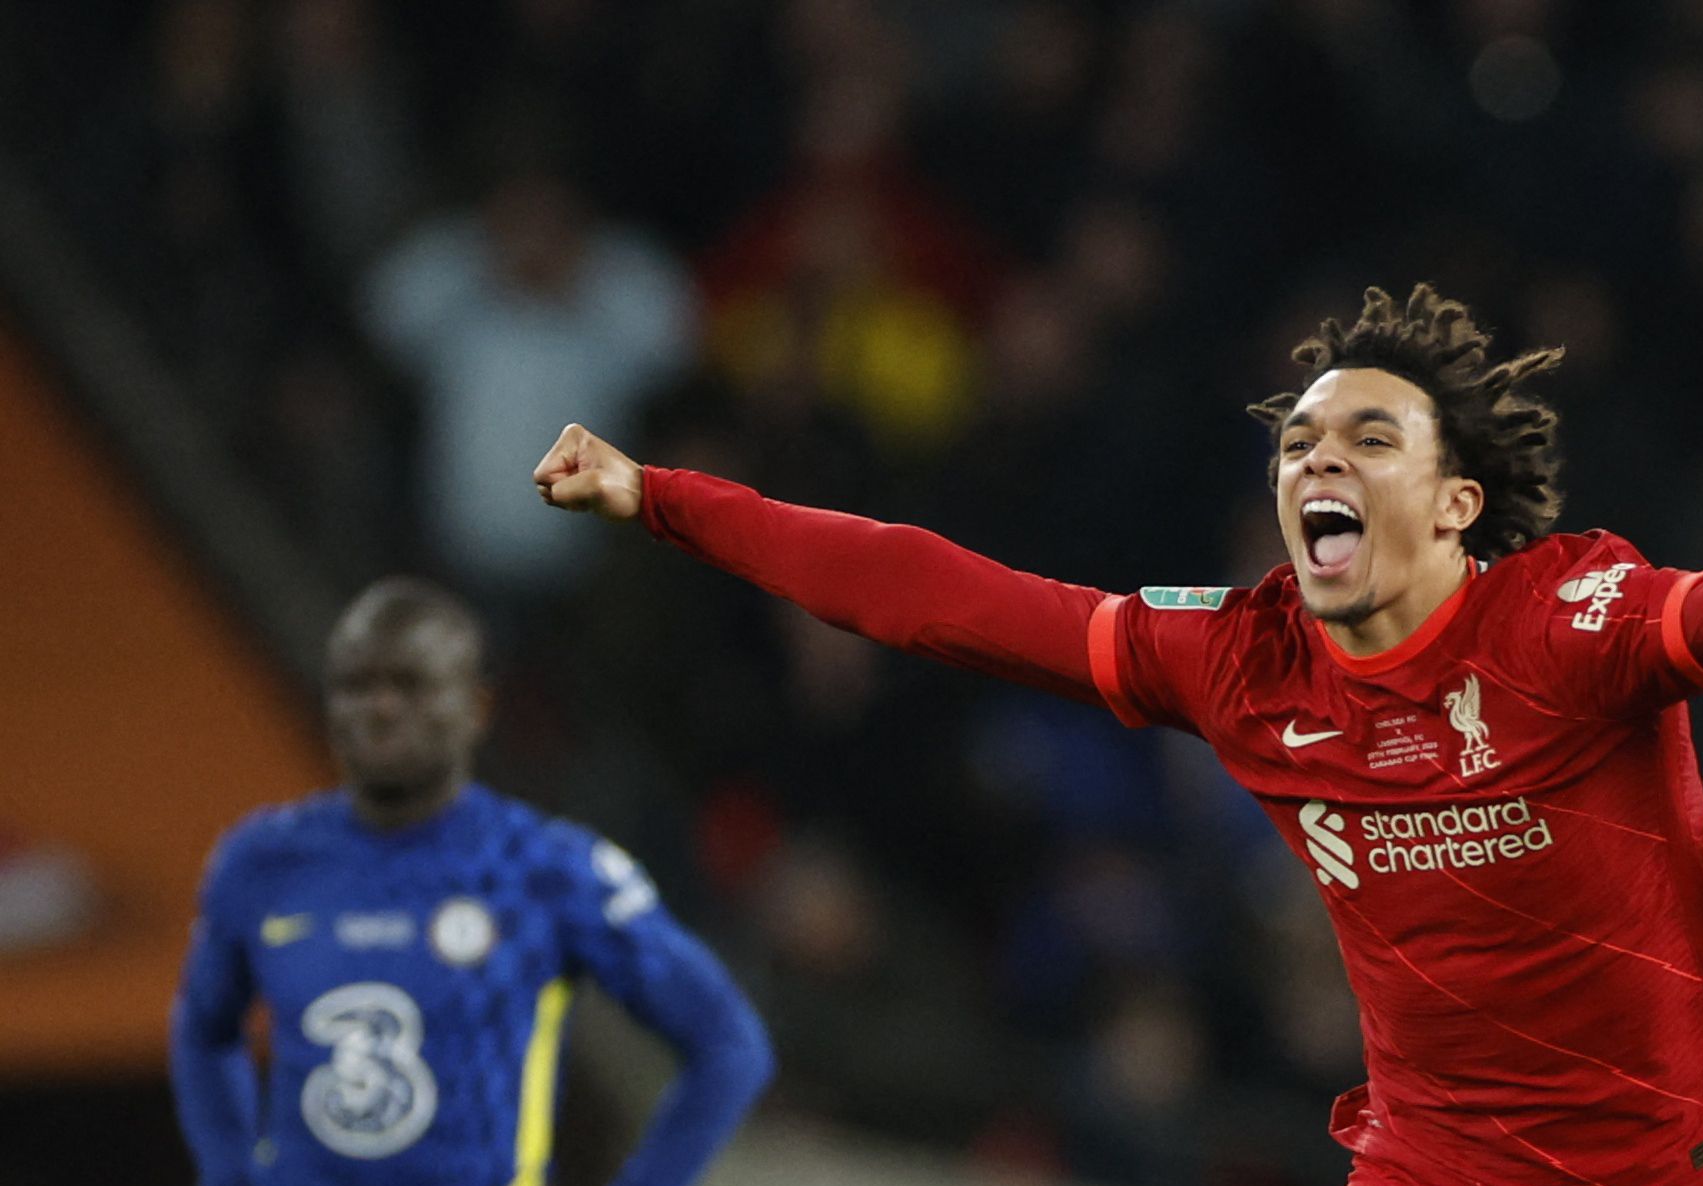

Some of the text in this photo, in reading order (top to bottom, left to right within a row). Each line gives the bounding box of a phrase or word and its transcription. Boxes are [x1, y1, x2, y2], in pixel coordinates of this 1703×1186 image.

[1360, 796, 1531, 841] standard
[1368, 818, 1553, 874] chartered
[302, 981, 438, 1160] 3
